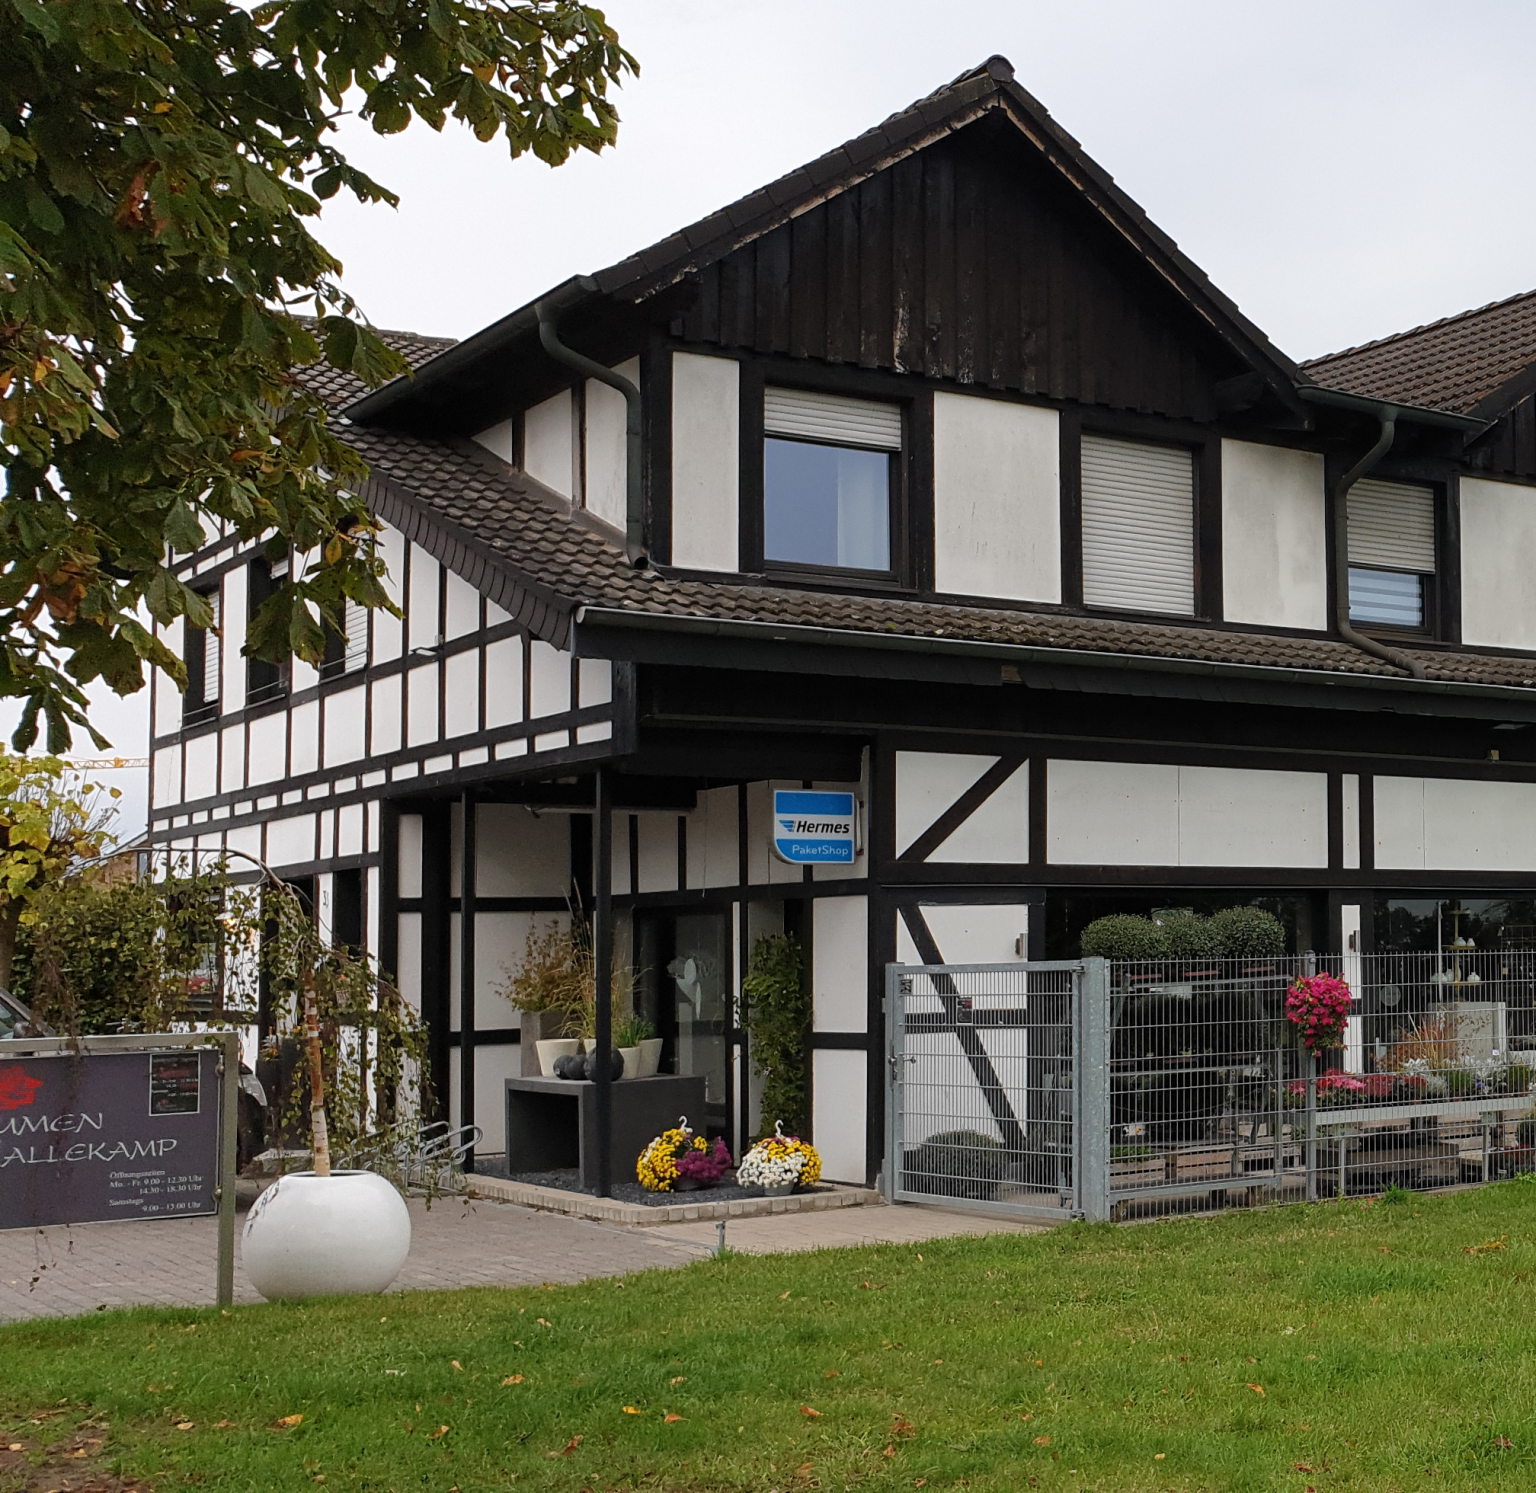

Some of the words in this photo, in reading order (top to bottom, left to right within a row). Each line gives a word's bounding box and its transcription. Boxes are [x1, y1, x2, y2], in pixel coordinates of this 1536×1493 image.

[796, 820, 850, 834] Hermes
[792, 844, 849, 857] PaketShop
[188, 1174, 202, 1182] Uhr
